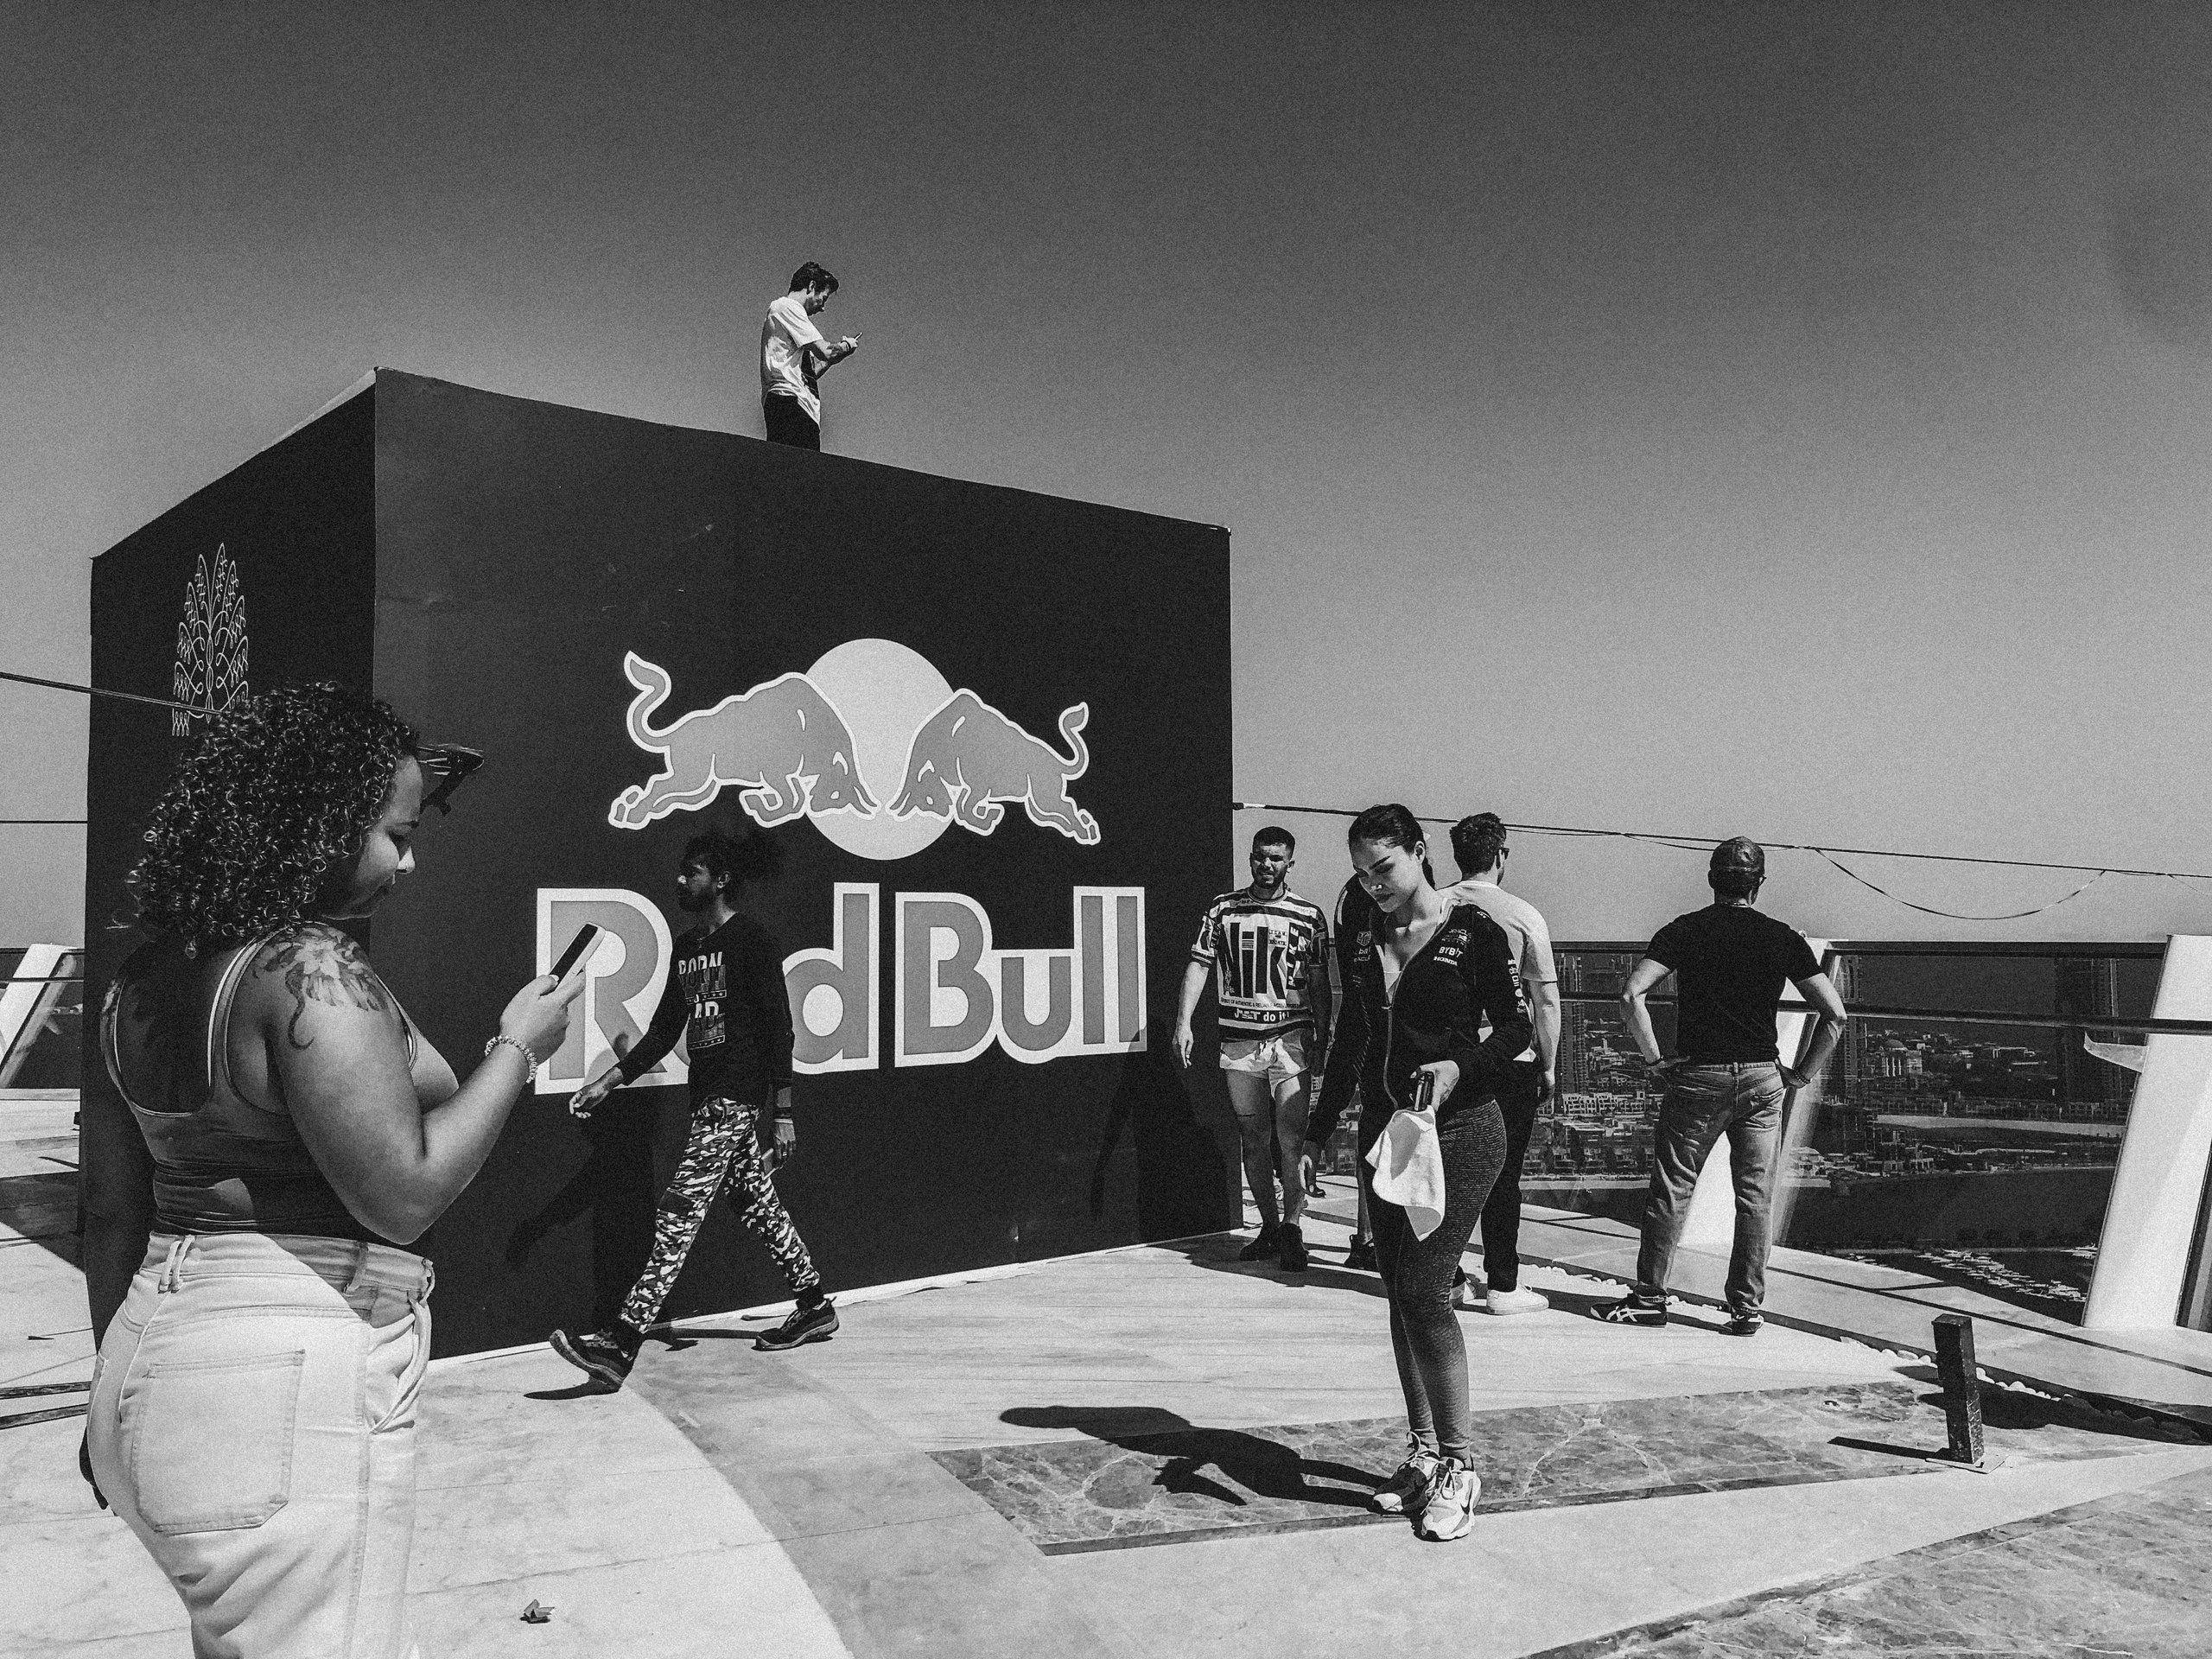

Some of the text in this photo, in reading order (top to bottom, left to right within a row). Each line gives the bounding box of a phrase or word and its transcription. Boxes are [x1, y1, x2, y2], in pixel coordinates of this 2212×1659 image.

[1439, 946, 1464, 958] BYBIT
[535, 882, 1147, 1093] Rd Bull
[1263, 1011, 1276, 1022] do
